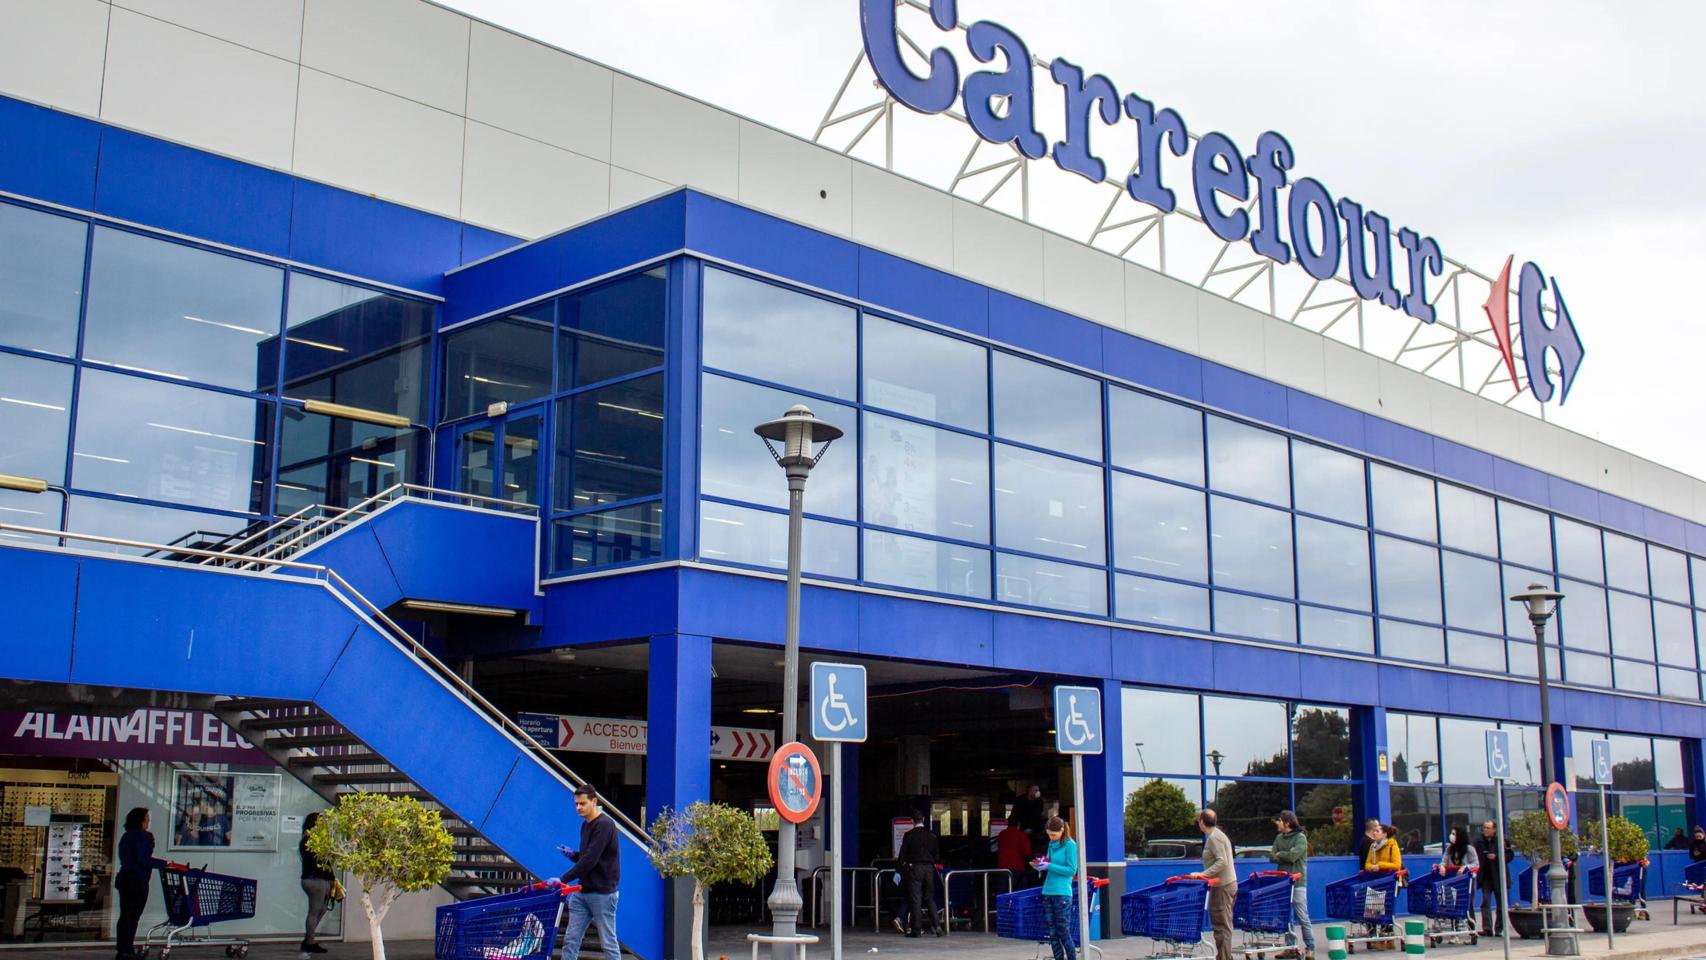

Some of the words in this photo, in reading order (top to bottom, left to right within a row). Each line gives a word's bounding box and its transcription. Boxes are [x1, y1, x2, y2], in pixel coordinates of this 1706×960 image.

[859, 0, 1443, 325] Carrefour
[583, 721, 639, 739] ACCESO
[609, 739, 647, 751] Bienven
